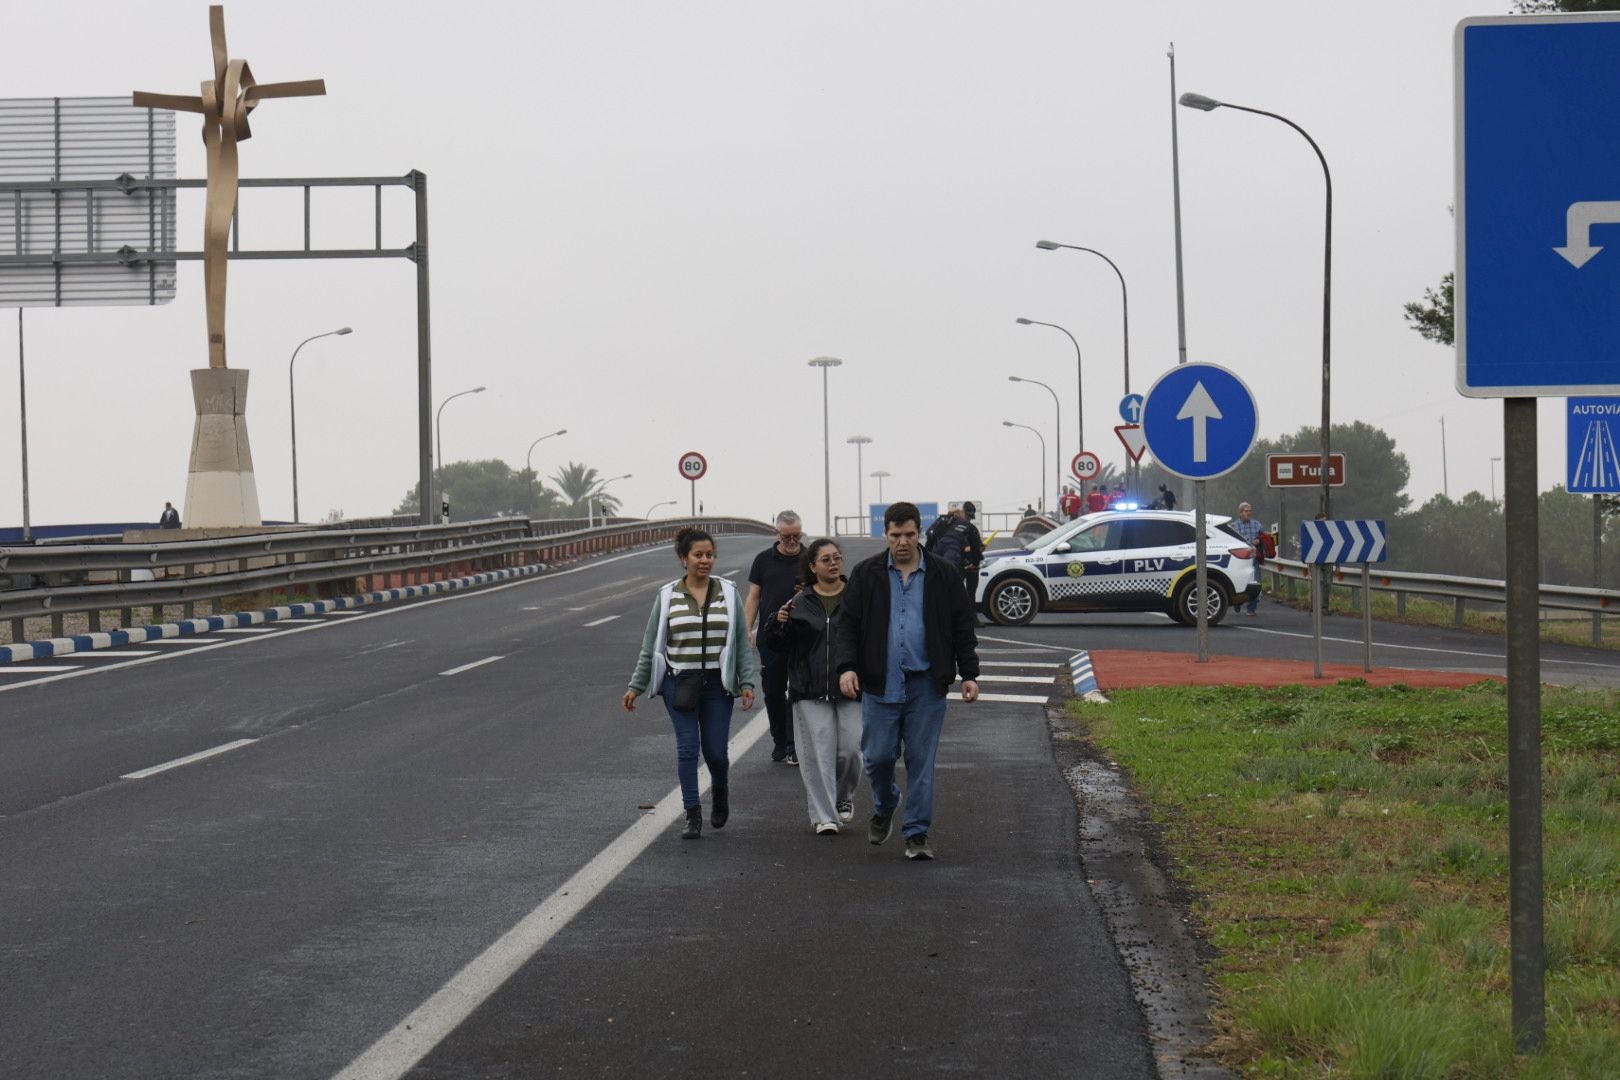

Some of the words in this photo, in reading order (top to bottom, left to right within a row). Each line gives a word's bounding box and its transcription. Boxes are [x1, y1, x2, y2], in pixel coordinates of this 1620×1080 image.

[684, 461, 701, 471] 80
[1078, 461, 1094, 471] 80
[1135, 559, 1165, 571] PLV
